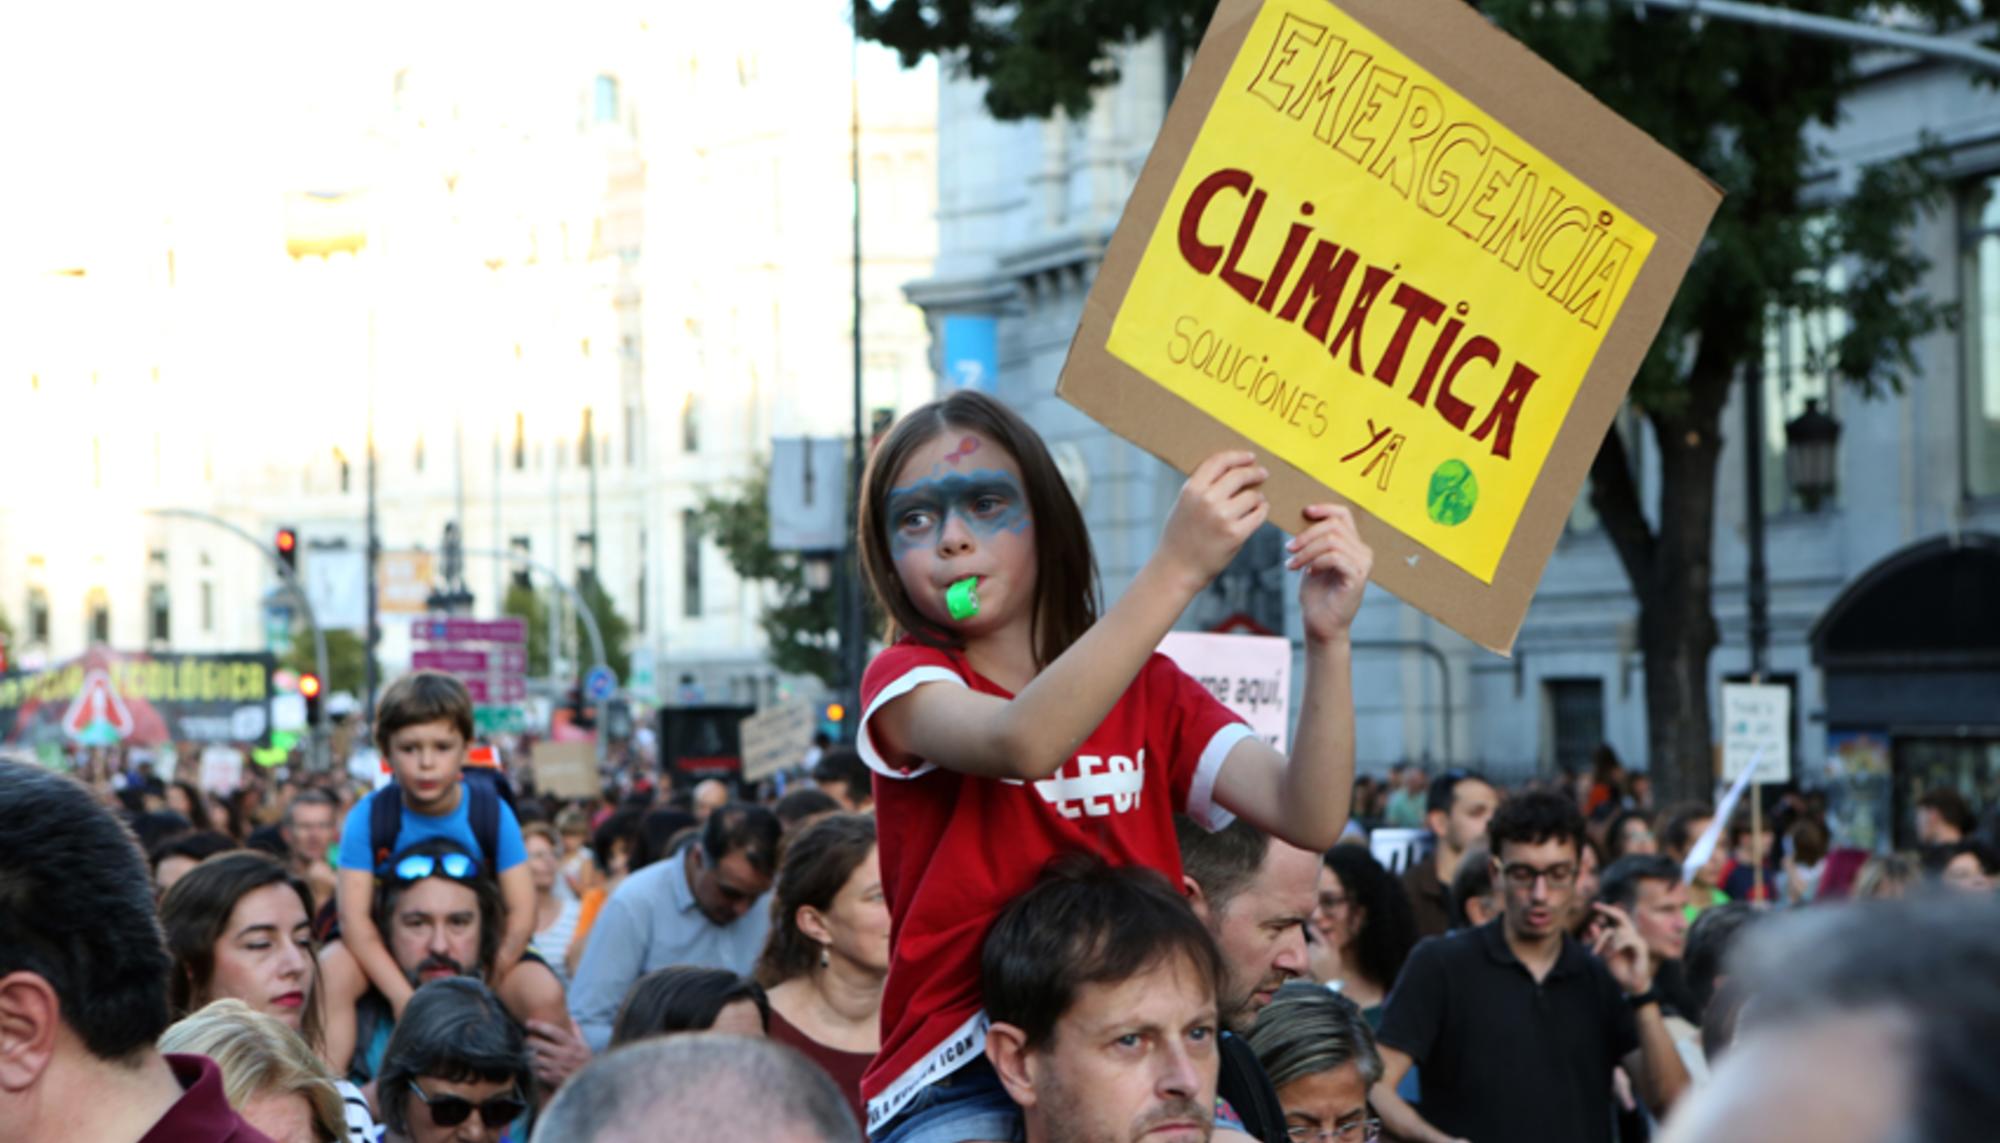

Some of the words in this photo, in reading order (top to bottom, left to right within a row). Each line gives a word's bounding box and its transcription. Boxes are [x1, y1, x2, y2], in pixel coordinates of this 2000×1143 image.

[1246, 11, 1634, 330] EMERGENCIA
[1167, 314, 1329, 439] SOLUCIONES
[1339, 418, 1407, 491] YA
